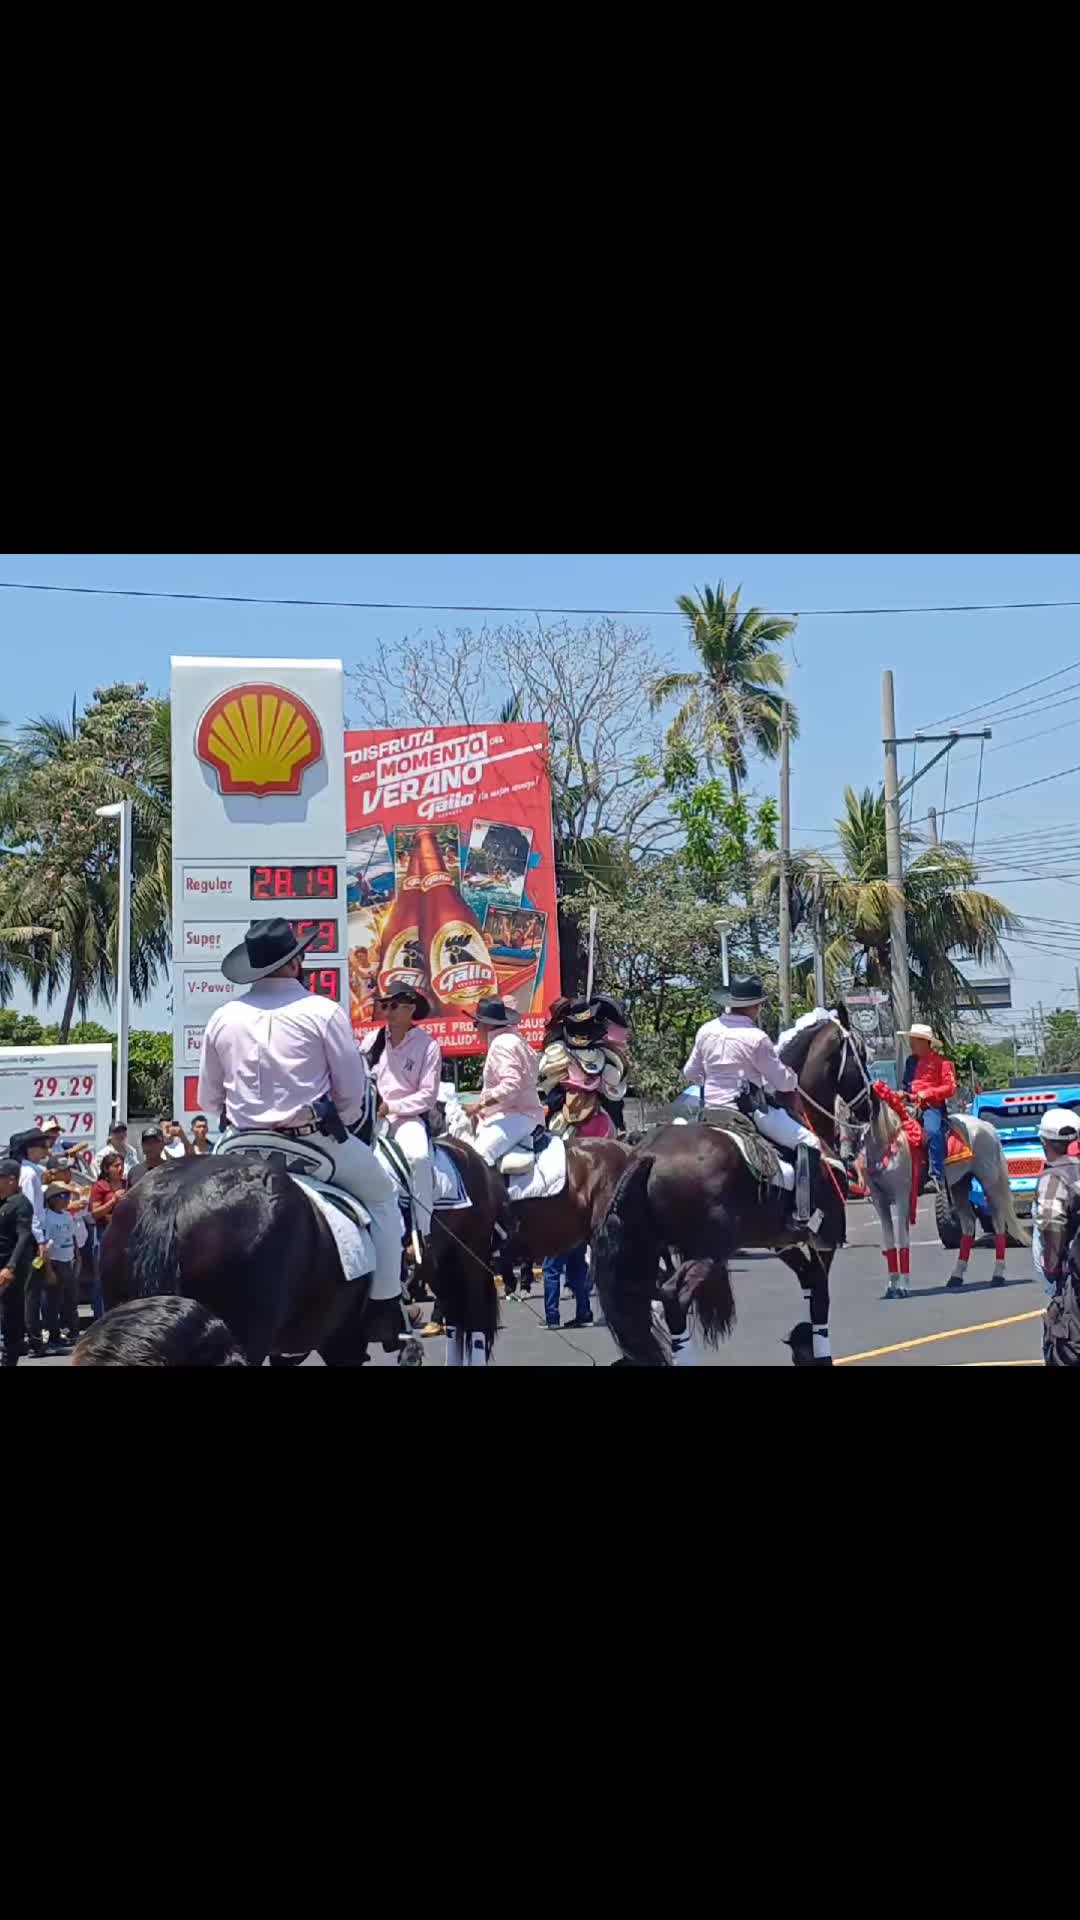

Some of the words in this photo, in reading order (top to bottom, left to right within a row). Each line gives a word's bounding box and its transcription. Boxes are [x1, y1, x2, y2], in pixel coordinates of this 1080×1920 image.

[350, 729, 434, 764] DISFRUTA
[380, 735, 485, 778] MOMENTO
[362, 763, 483, 815] VERANO
[417, 791, 475, 820] Gallo
[186, 876, 232, 893] Regular
[255, 868, 335, 896] 28.19
[186, 932, 221, 947] Super
[188, 981, 234, 993] V-Power
[440, 964, 492, 992] Gallo
[451, 1021, 478, 1032] PRO
[34, 1076, 93, 1098] 29.29
